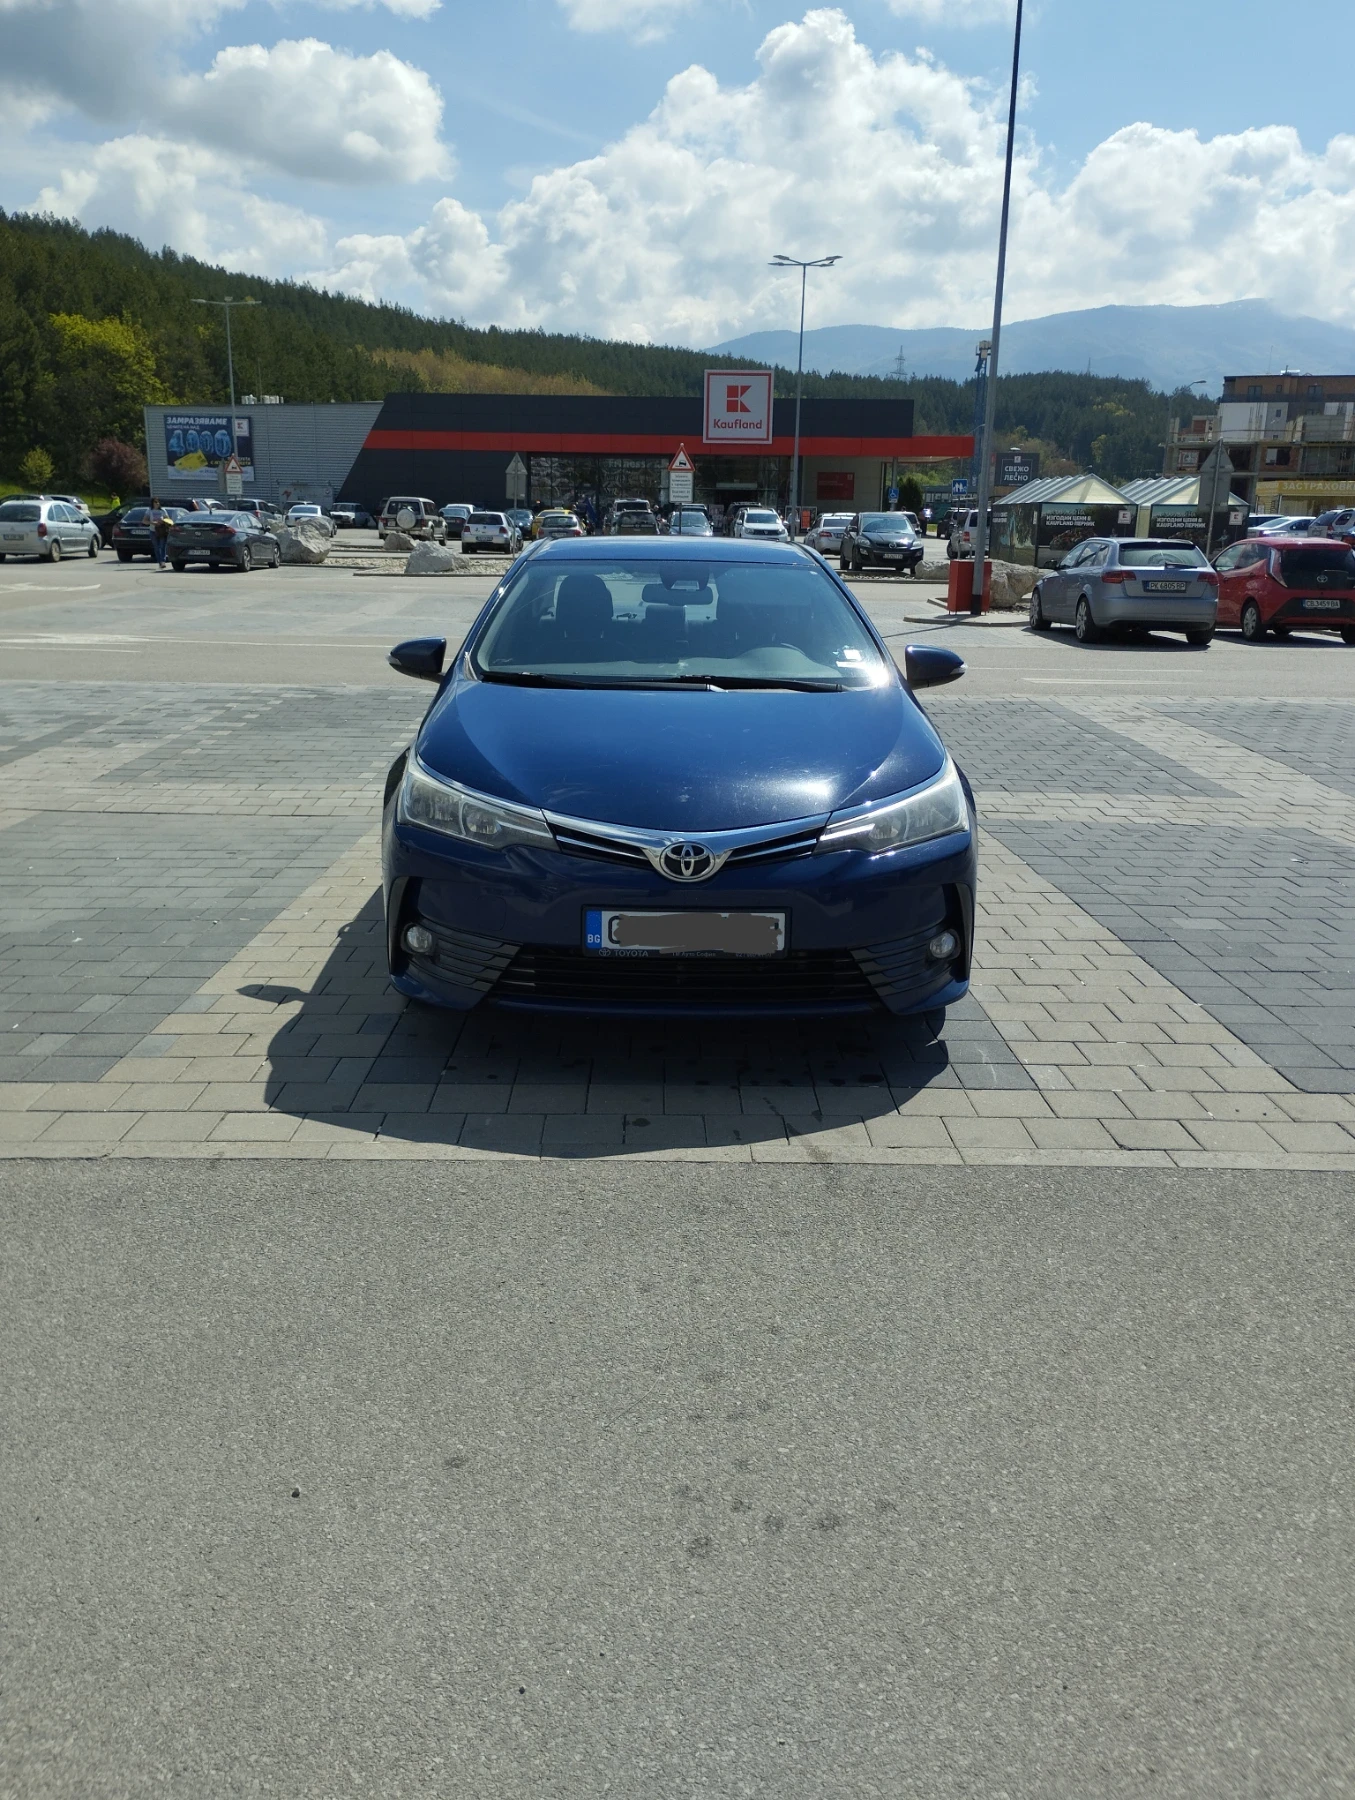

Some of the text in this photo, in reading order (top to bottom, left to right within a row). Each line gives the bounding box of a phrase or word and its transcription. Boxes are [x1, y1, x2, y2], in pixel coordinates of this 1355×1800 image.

[726, 385, 752, 412] K
[167, 417, 228, 425] ЗАМРАЗЯВАМЕ
[713, 419, 762, 430] Kaufland
[168, 430, 232, 457] 4000
[587, 934, 600, 943] BG
